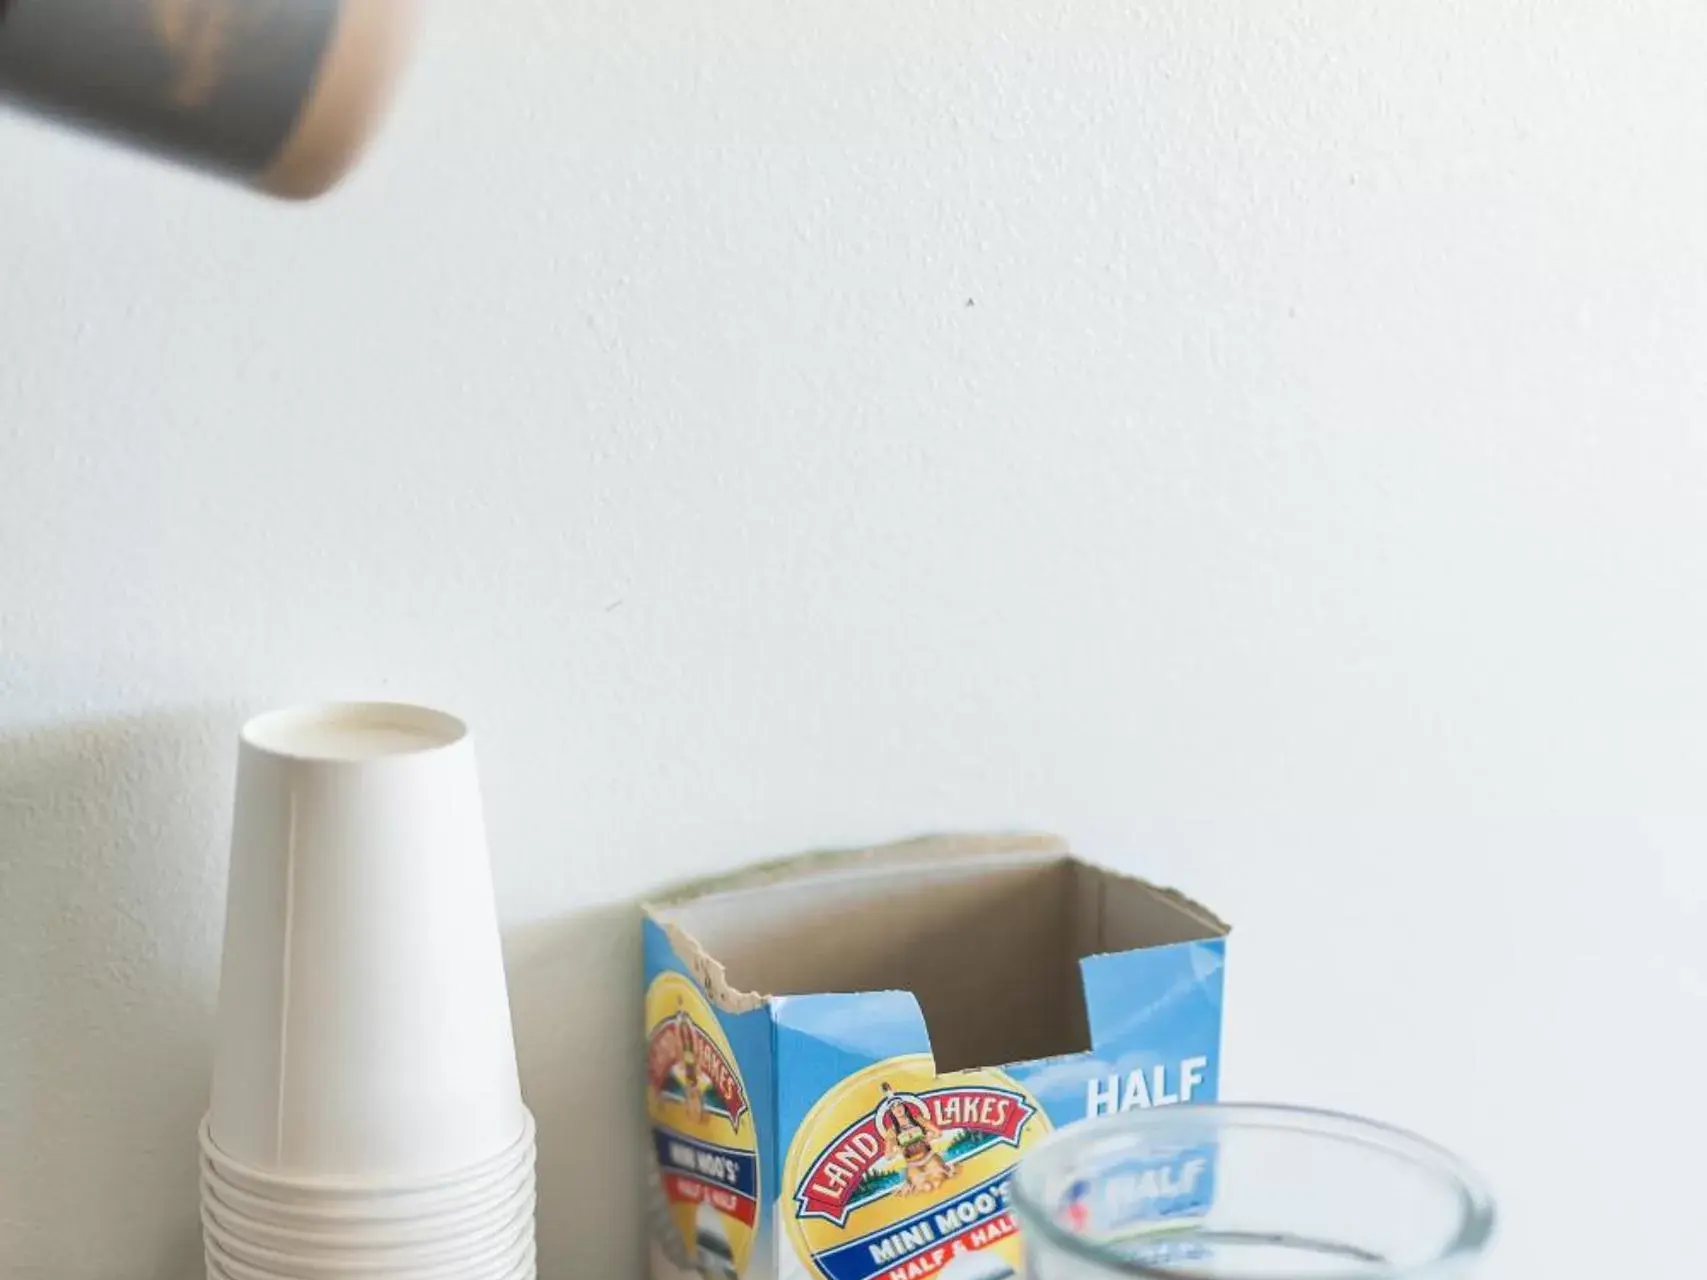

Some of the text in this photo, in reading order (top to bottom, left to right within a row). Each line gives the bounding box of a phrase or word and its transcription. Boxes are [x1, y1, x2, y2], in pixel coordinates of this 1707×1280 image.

[1087, 1056, 1207, 1118] HALF
[812, 1096, 1011, 1198] LAND LAKES
[868, 1221, 935, 1265] MINI
